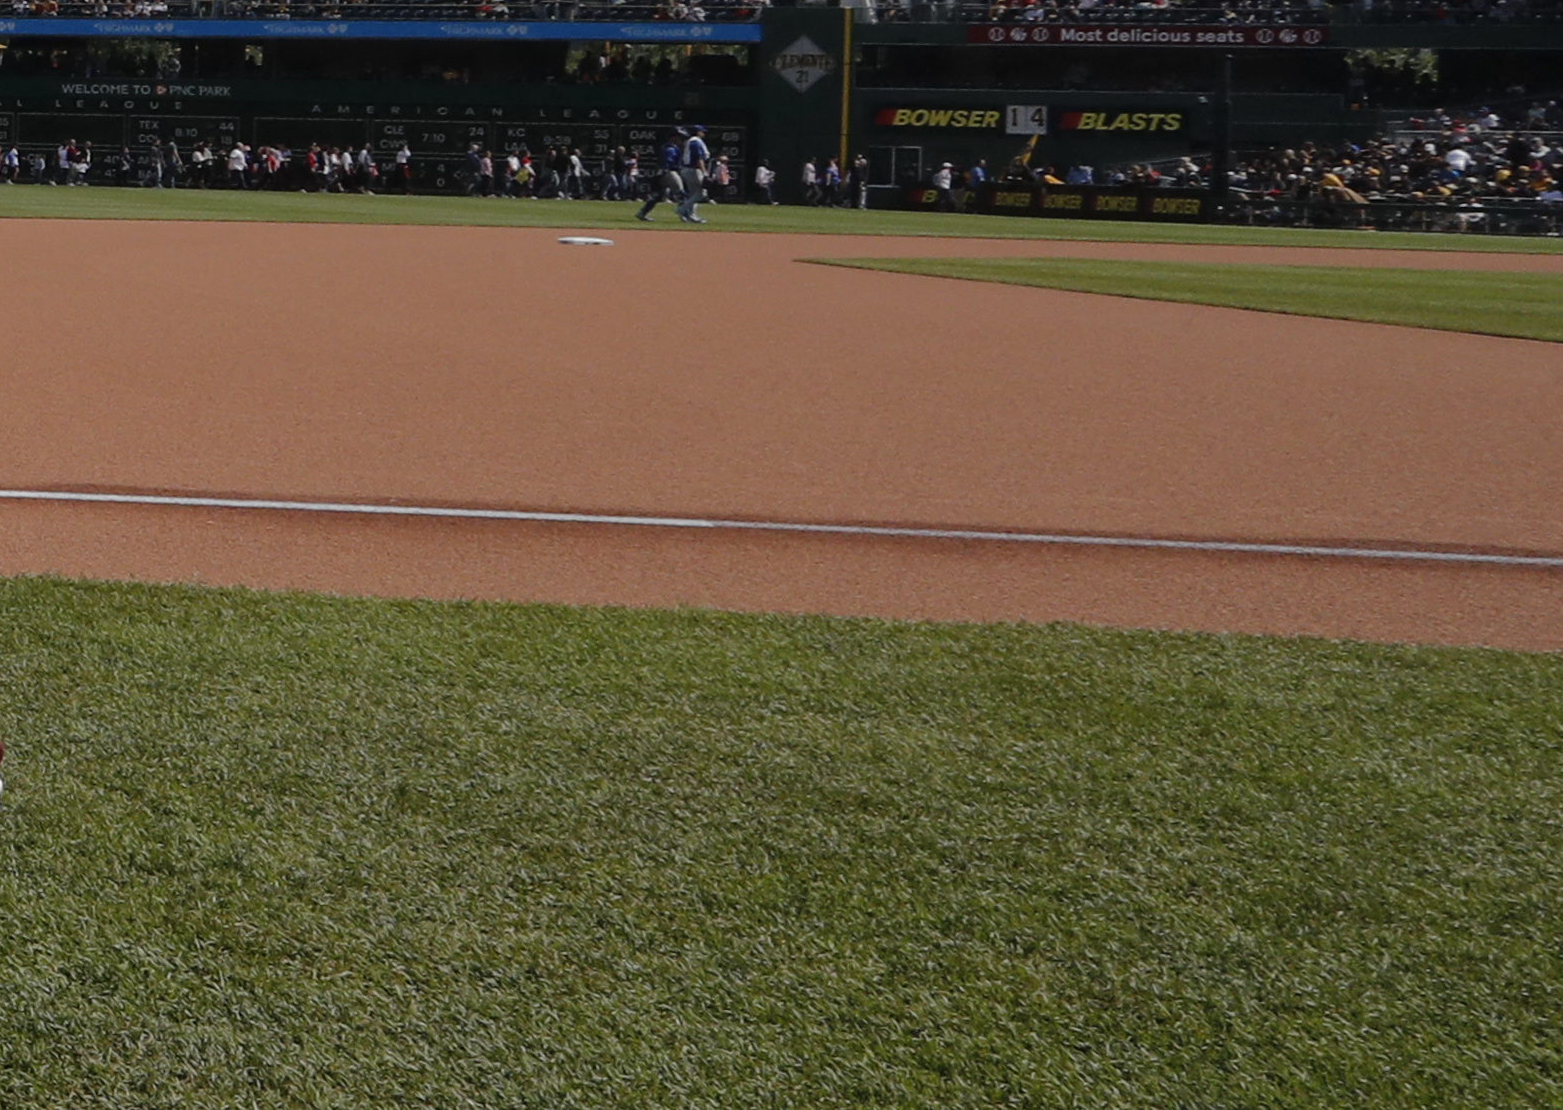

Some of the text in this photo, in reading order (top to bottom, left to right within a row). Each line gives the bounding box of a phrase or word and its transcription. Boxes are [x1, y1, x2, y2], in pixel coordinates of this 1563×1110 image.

[1059, 26, 1245, 44] Most delicious seats
[796, 70, 809, 84] 21
[61, 83, 231, 97] WELCOME TO PNC PARK
[311, 104, 683, 120] AMERICAN LEAGUE
[892, 108, 1001, 128] BOWSER
[1076, 112, 1183, 131] BLASTS
[138, 120, 160, 130] TEX
[384, 125, 405, 135] CLE
[468, 127, 485, 136] 24
[507, 128, 526, 137] KC
[629, 130, 657, 140] OAK
[994, 191, 1031, 207] BOWSER
[1043, 193, 1083, 210] BOWSER
[1095, 195, 1138, 212] BOWSER
[1151, 197, 1201, 216] BOWSER
